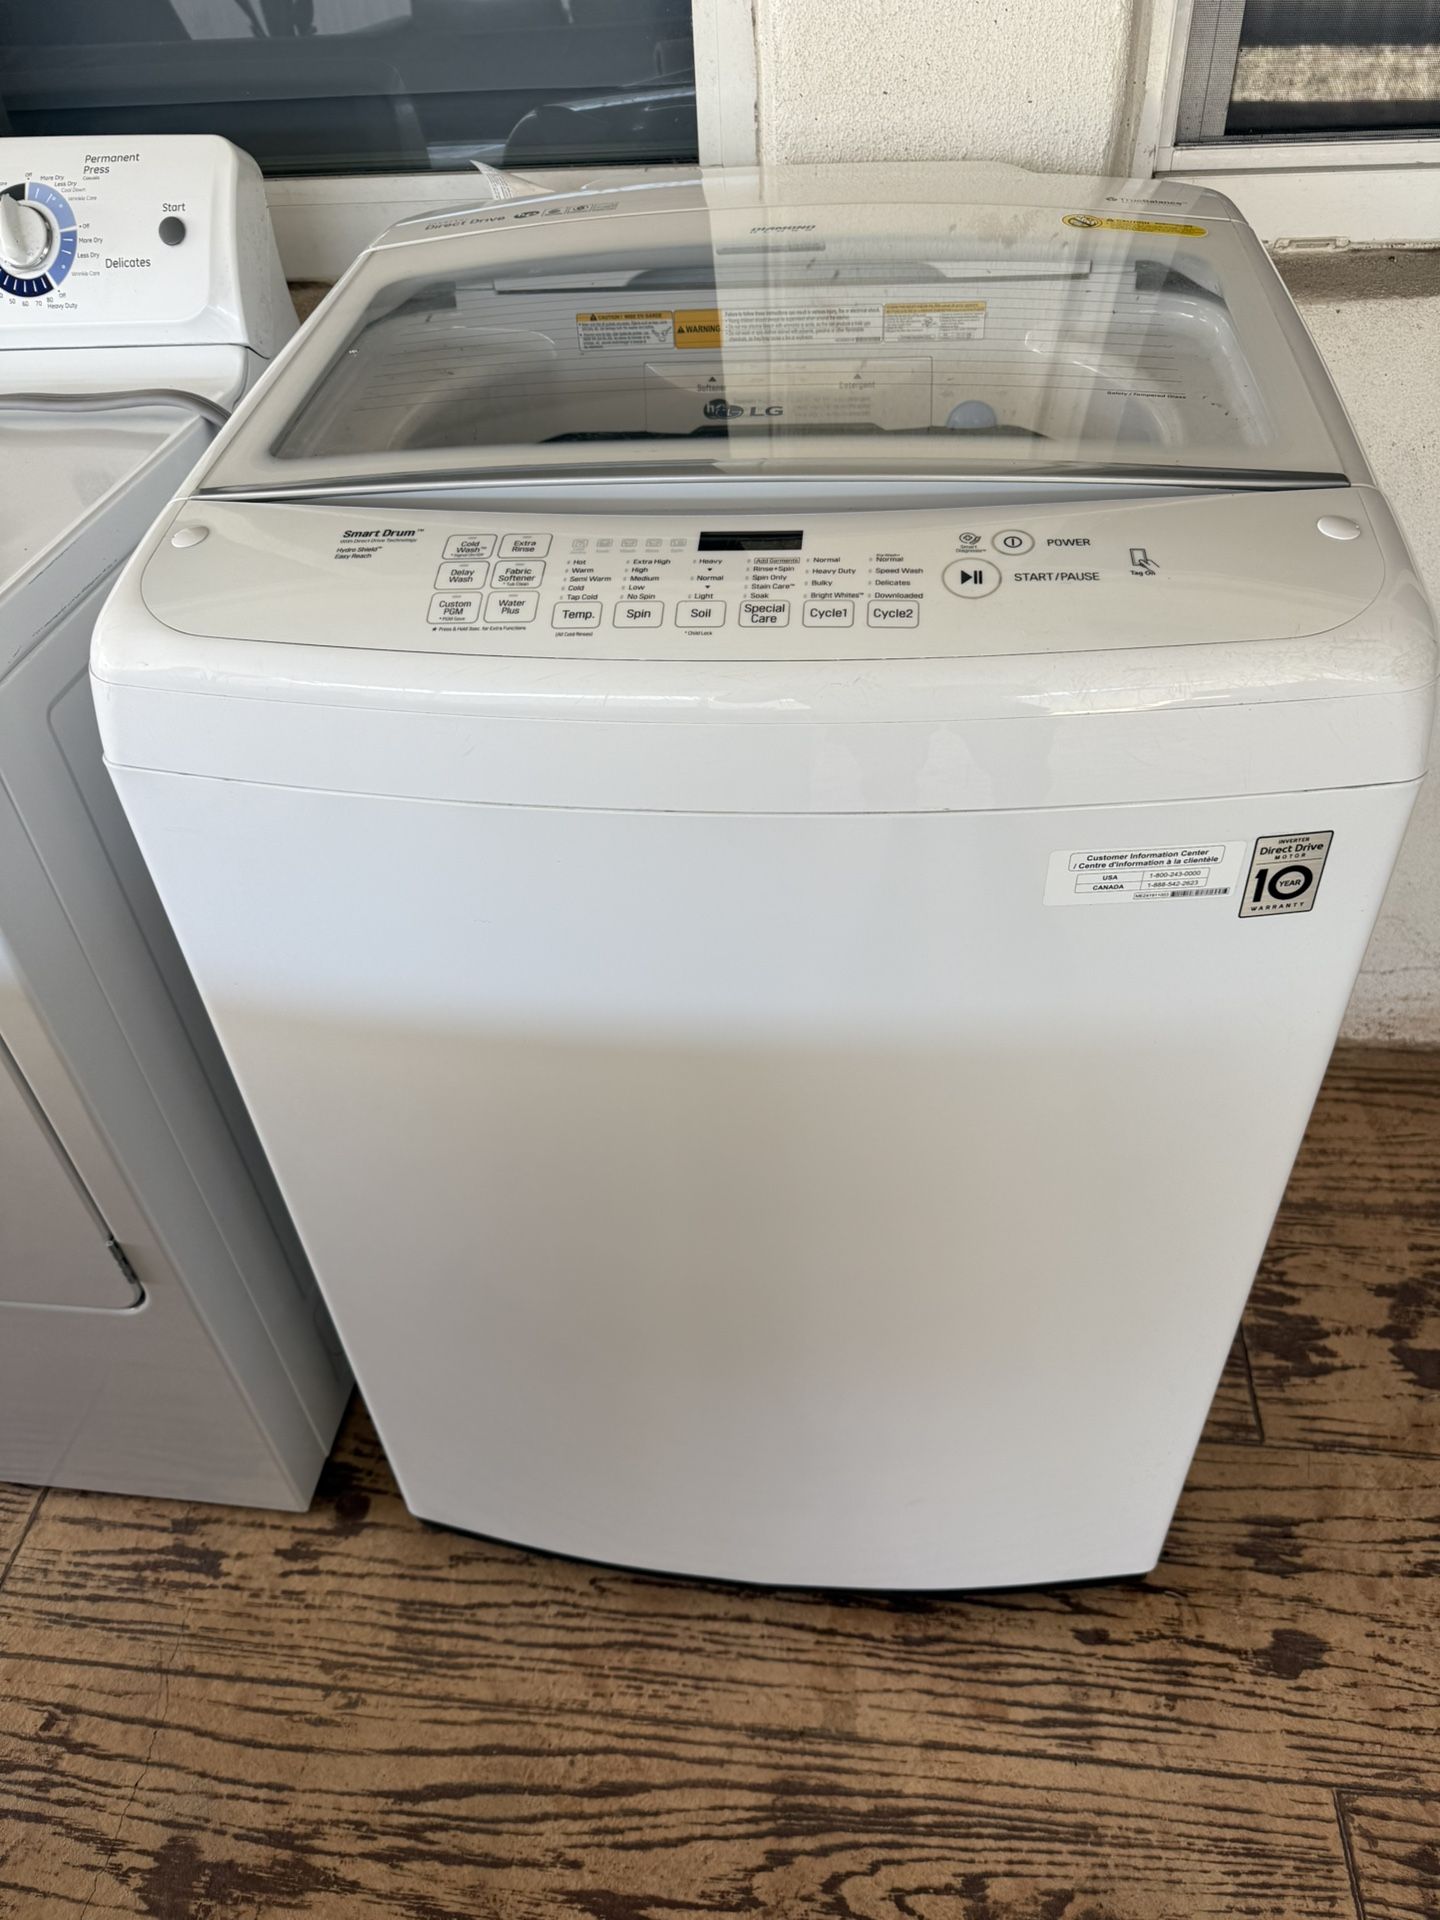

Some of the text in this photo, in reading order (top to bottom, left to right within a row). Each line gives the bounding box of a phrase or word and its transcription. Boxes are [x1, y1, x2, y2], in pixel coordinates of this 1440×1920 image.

[84, 153, 140, 164] Permanent
[83, 165, 110, 175] Press
[162, 202, 186, 212] Start
[425, 215, 505, 231] Direct Drive
[105, 257, 151, 269] Delicates
[686, 325, 721, 333] WARNING
[750, 406, 784, 417] LG
[343, 529, 380, 538] Smart
[1047, 538, 1091, 546] POWER
[450, 569, 475, 577] Delay
[838, 567, 856, 575] Duty
[811, 579, 833, 587] Bulky
[810, 592, 833, 600] Bright
[439, 600, 472, 608] Custom
[498, 599, 526, 607] Water
[443, 607, 464, 615] PGM
[501, 606, 520, 615] Plus
[690, 608, 712, 618] Soil
[744, 603, 786, 614] Special
[810, 608, 847, 619] Cycle1
[873, 608, 913, 619] Cycle2
[562, 609, 595, 621] Temp.
[626, 609, 651, 620] Spin
[751, 614, 777, 624] Care
[1278, 836, 1310, 844] INVERTER
[1259, 842, 1324, 855] Direct Drive
[1086, 849, 1209, 862] Customer Information Center
[1078, 861, 1107, 870] Centre
[1108, 858, 1165, 868] d'information
[1183, 856, 1218, 865] clientèle
[1092, 883, 1124, 891] CANADA
[1252, 864, 1313, 903] 10
[1279, 879, 1302, 887] YEAR
[1250, 901, 1305, 912] WARRANTY
